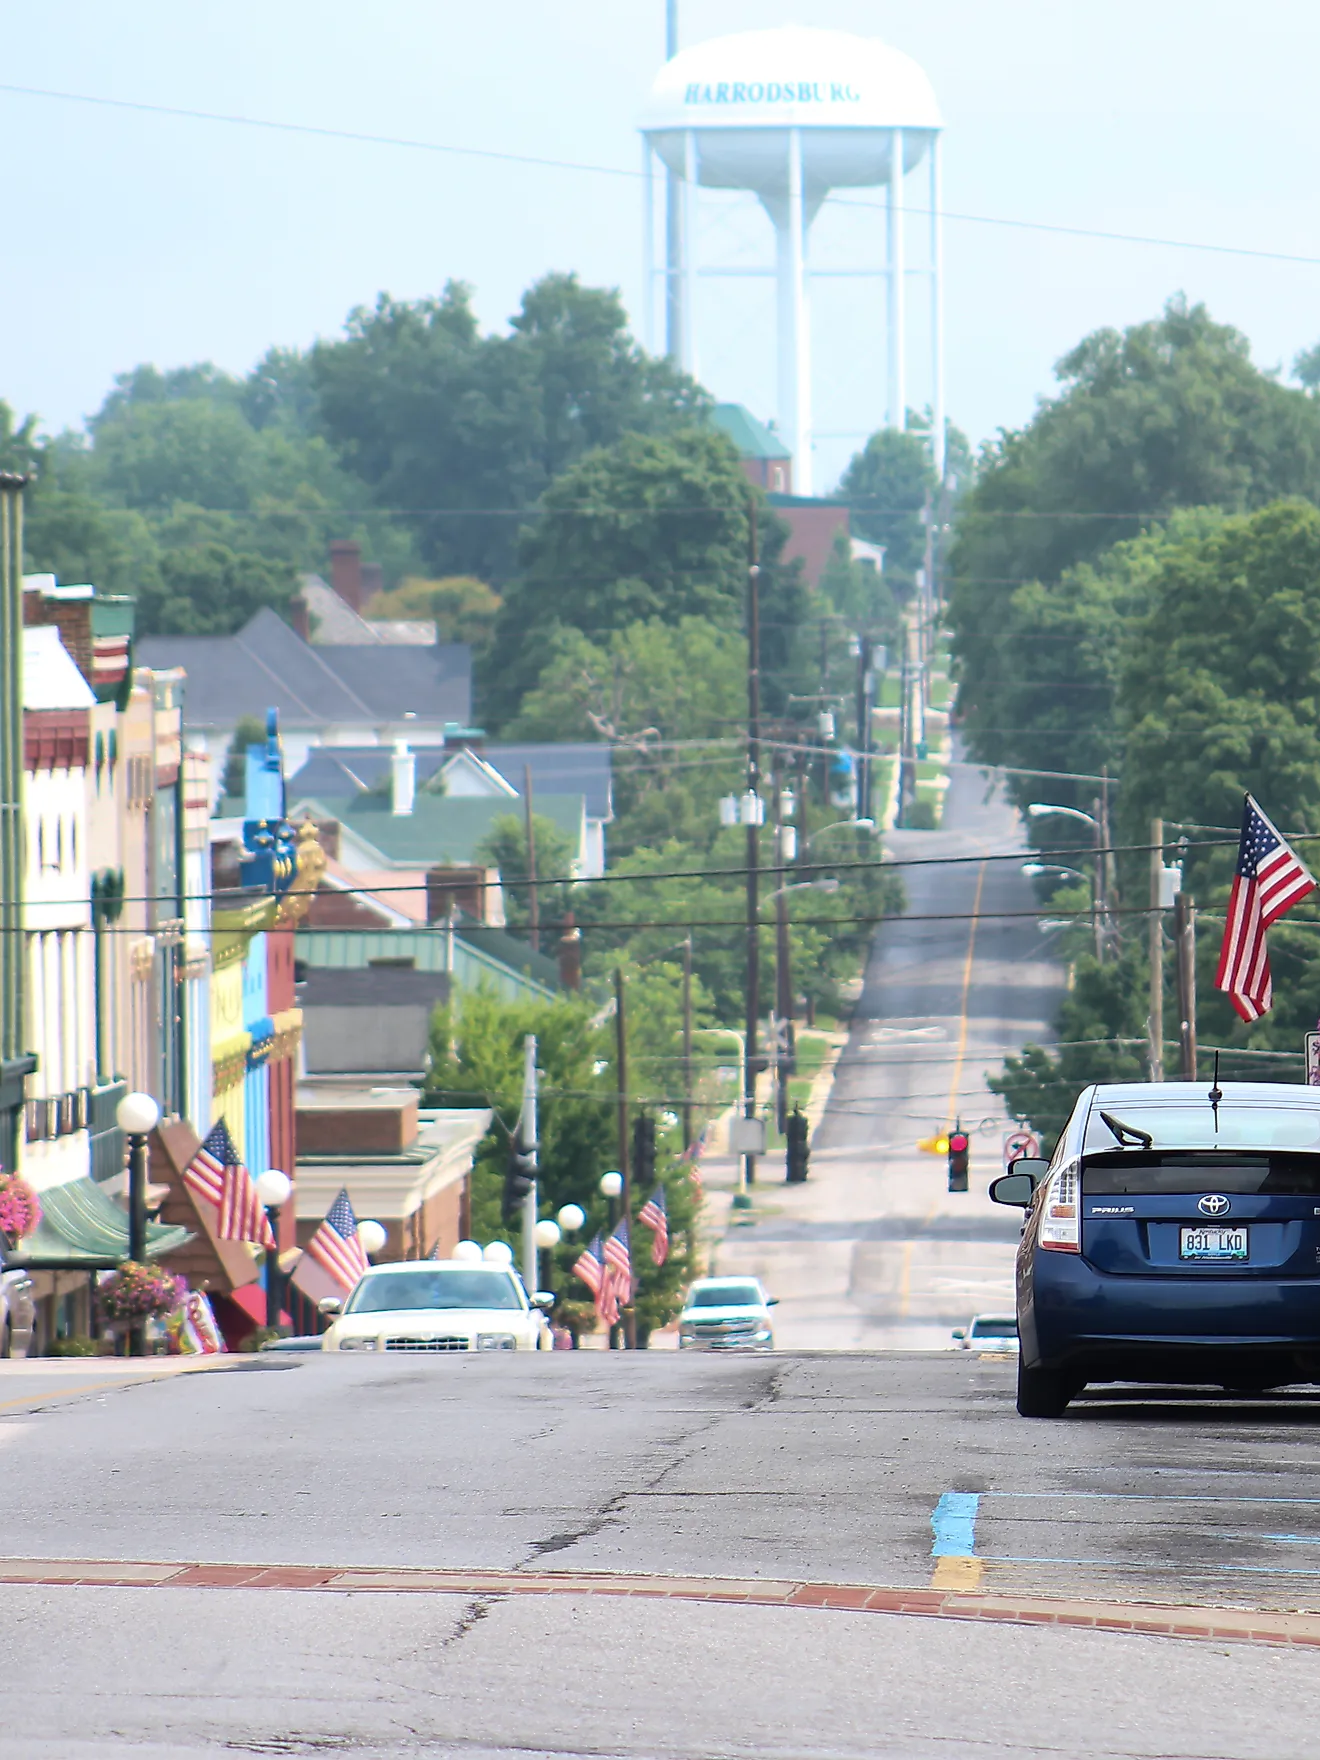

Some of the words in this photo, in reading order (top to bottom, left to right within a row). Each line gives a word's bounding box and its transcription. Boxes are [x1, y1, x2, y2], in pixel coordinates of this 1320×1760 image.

[684, 81, 861, 105] HARRODSBURG
[1091, 1206, 1135, 1214] PRIUS
[1187, 1234, 1211, 1251] 831
[1219, 1234, 1242, 1251] LKD
